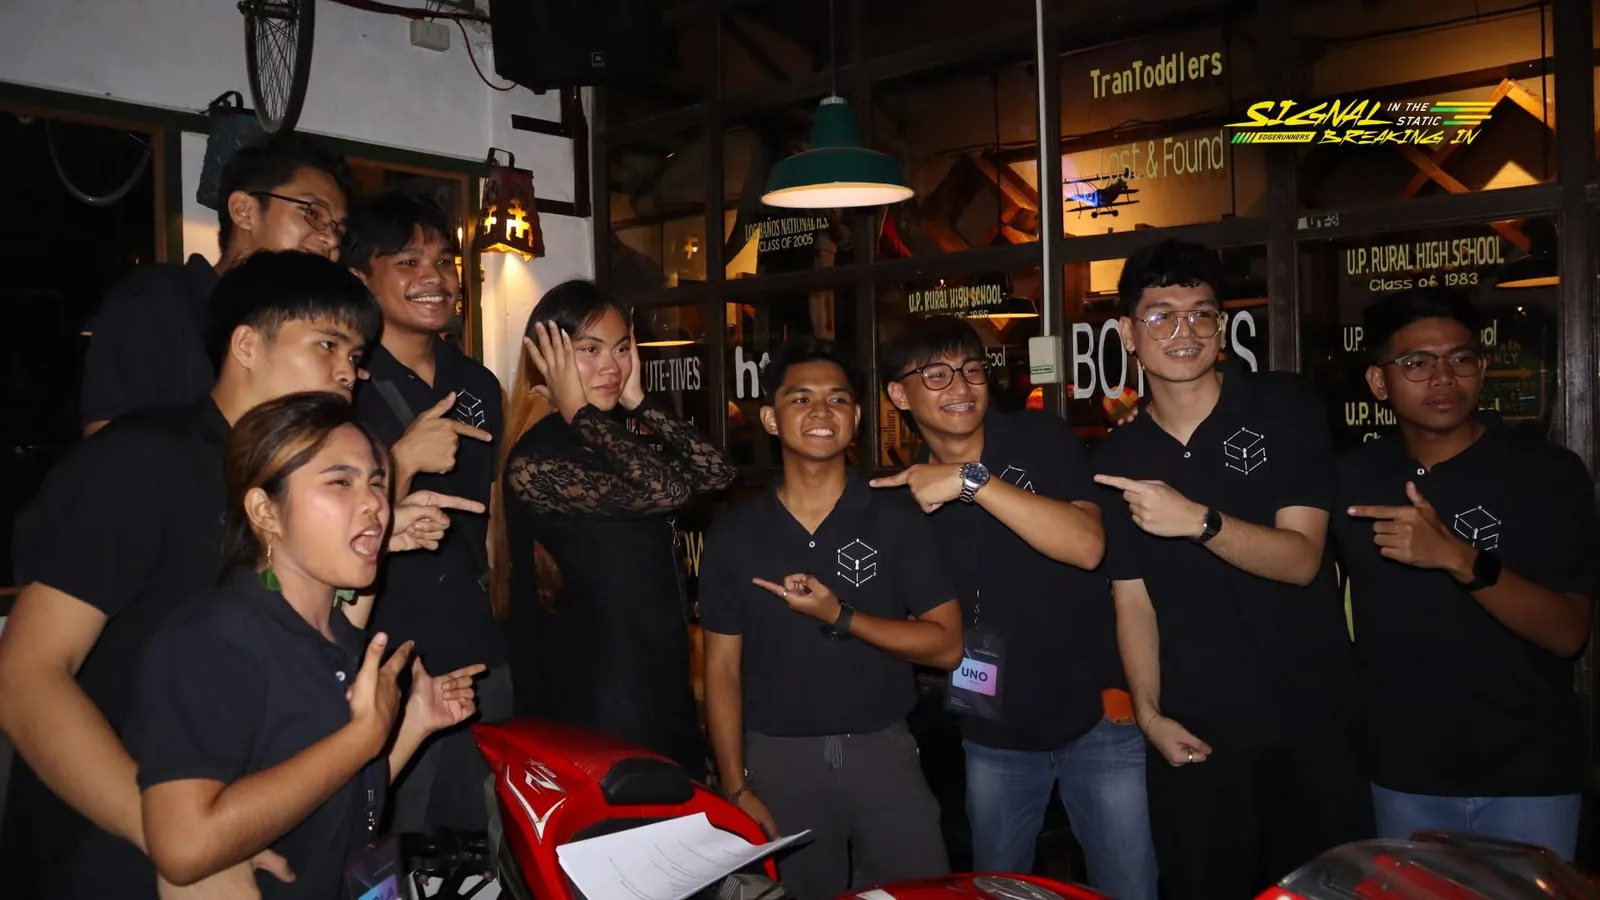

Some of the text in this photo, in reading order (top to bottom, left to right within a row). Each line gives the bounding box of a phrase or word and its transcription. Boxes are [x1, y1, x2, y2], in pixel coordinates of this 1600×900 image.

[1090, 51, 1223, 99] TranToddlers
[1100, 129, 1224, 185] Lost & Found
[780, 217, 816, 236] NATIONAL
[758, 233, 814, 253] CLASS OF 2005
[1347, 235, 1505, 275] U.P. RURAL HIGH SCHOOL
[1369, 272, 1479, 292] Class of 1983
[908, 292, 923, 314] U.P.
[971, 284, 1002, 308] SCHOOL
[1343, 326, 1366, 352] U.P.
[1345, 402, 1371, 426] U.P.
[961, 666, 988, 682] UNO
